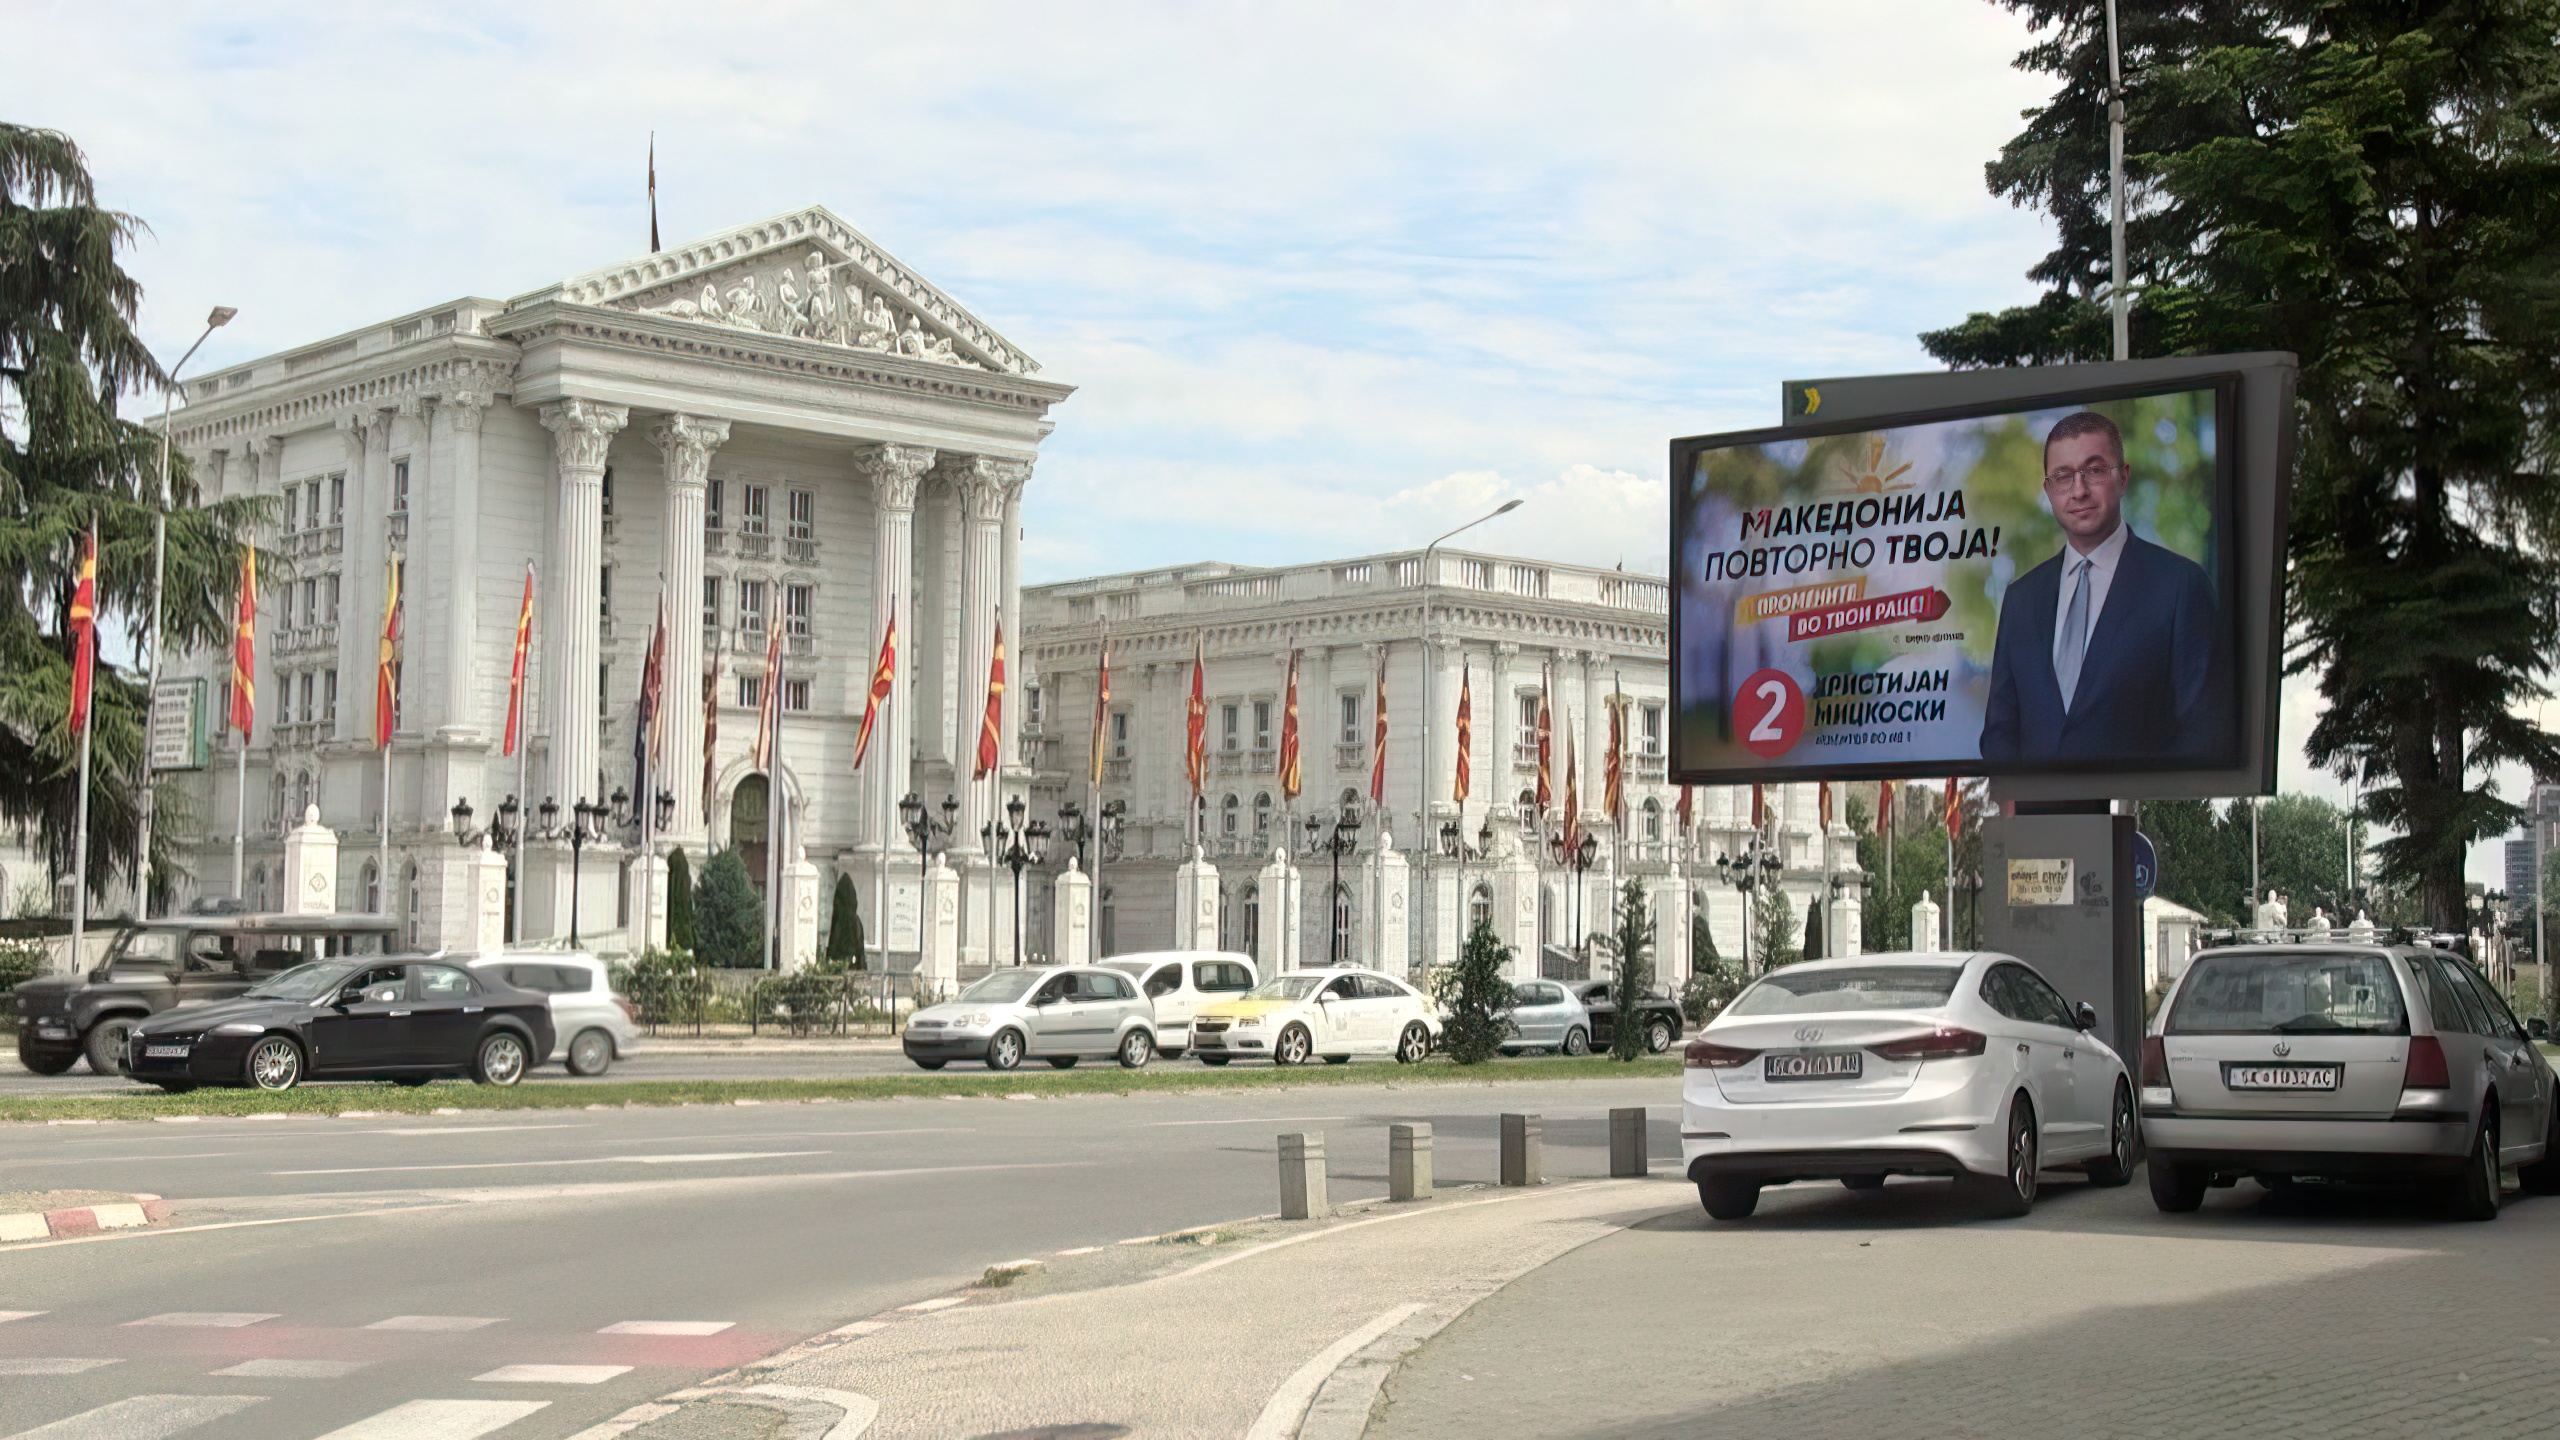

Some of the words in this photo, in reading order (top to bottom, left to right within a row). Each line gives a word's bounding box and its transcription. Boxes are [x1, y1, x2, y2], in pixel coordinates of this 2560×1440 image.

[1740, 489, 1966, 541] МАКЕДОНИЈА
[1705, 537, 1875, 581] ПОВТОРНО
[1886, 526, 2000, 564] ТВОЈА!
[1749, 680, 1787, 742] 2
[1814, 699, 1946, 727] МИЦКОСКИ
